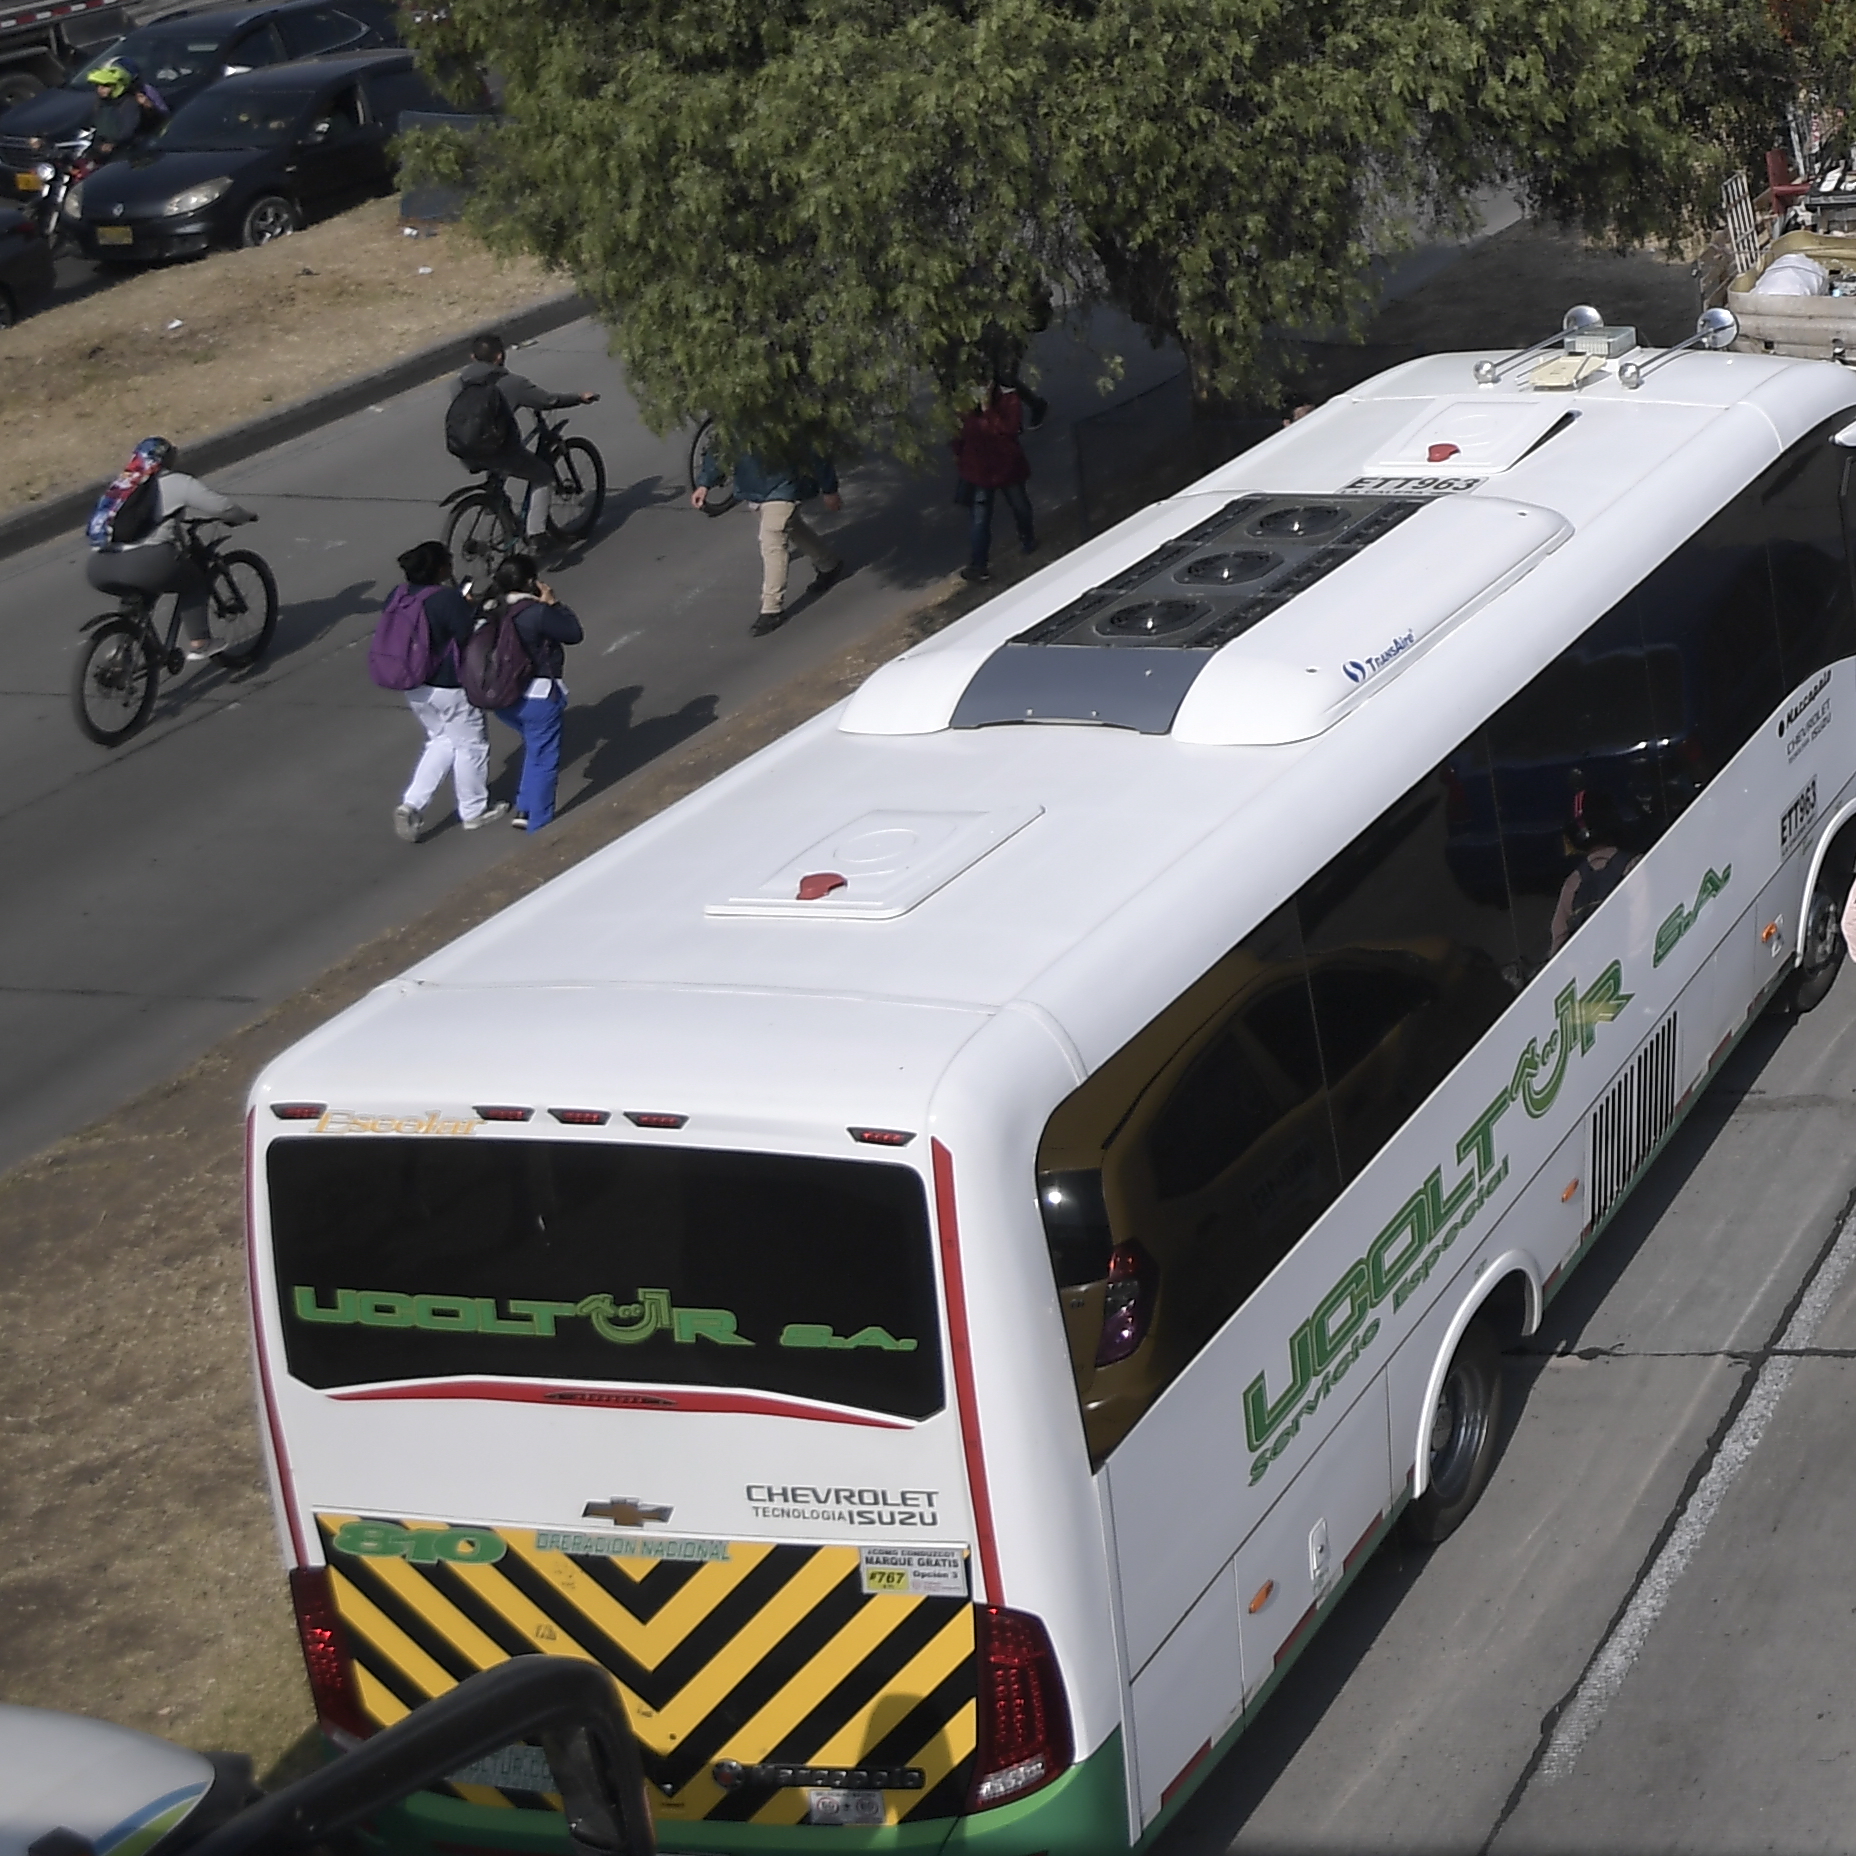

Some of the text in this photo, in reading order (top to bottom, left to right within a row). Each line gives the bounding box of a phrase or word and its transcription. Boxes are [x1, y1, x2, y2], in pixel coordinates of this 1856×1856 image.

[1344, 476, 1481, 491] ETT963
[309, 1108, 487, 1135] Escolar
[1391, 1154, 1511, 1315] Especial
[1246, 1317, 1382, 1487] Servicio
[746, 1484, 940, 1508] CHEVROLET
[752, 1505, 939, 1526] TECNOLOGIA ISUZU
[334, 1520, 508, 1565] 810
[639, 1535, 732, 1562] NACIONAL
[865, 1556, 960, 1568] MARQUE GRATIS
